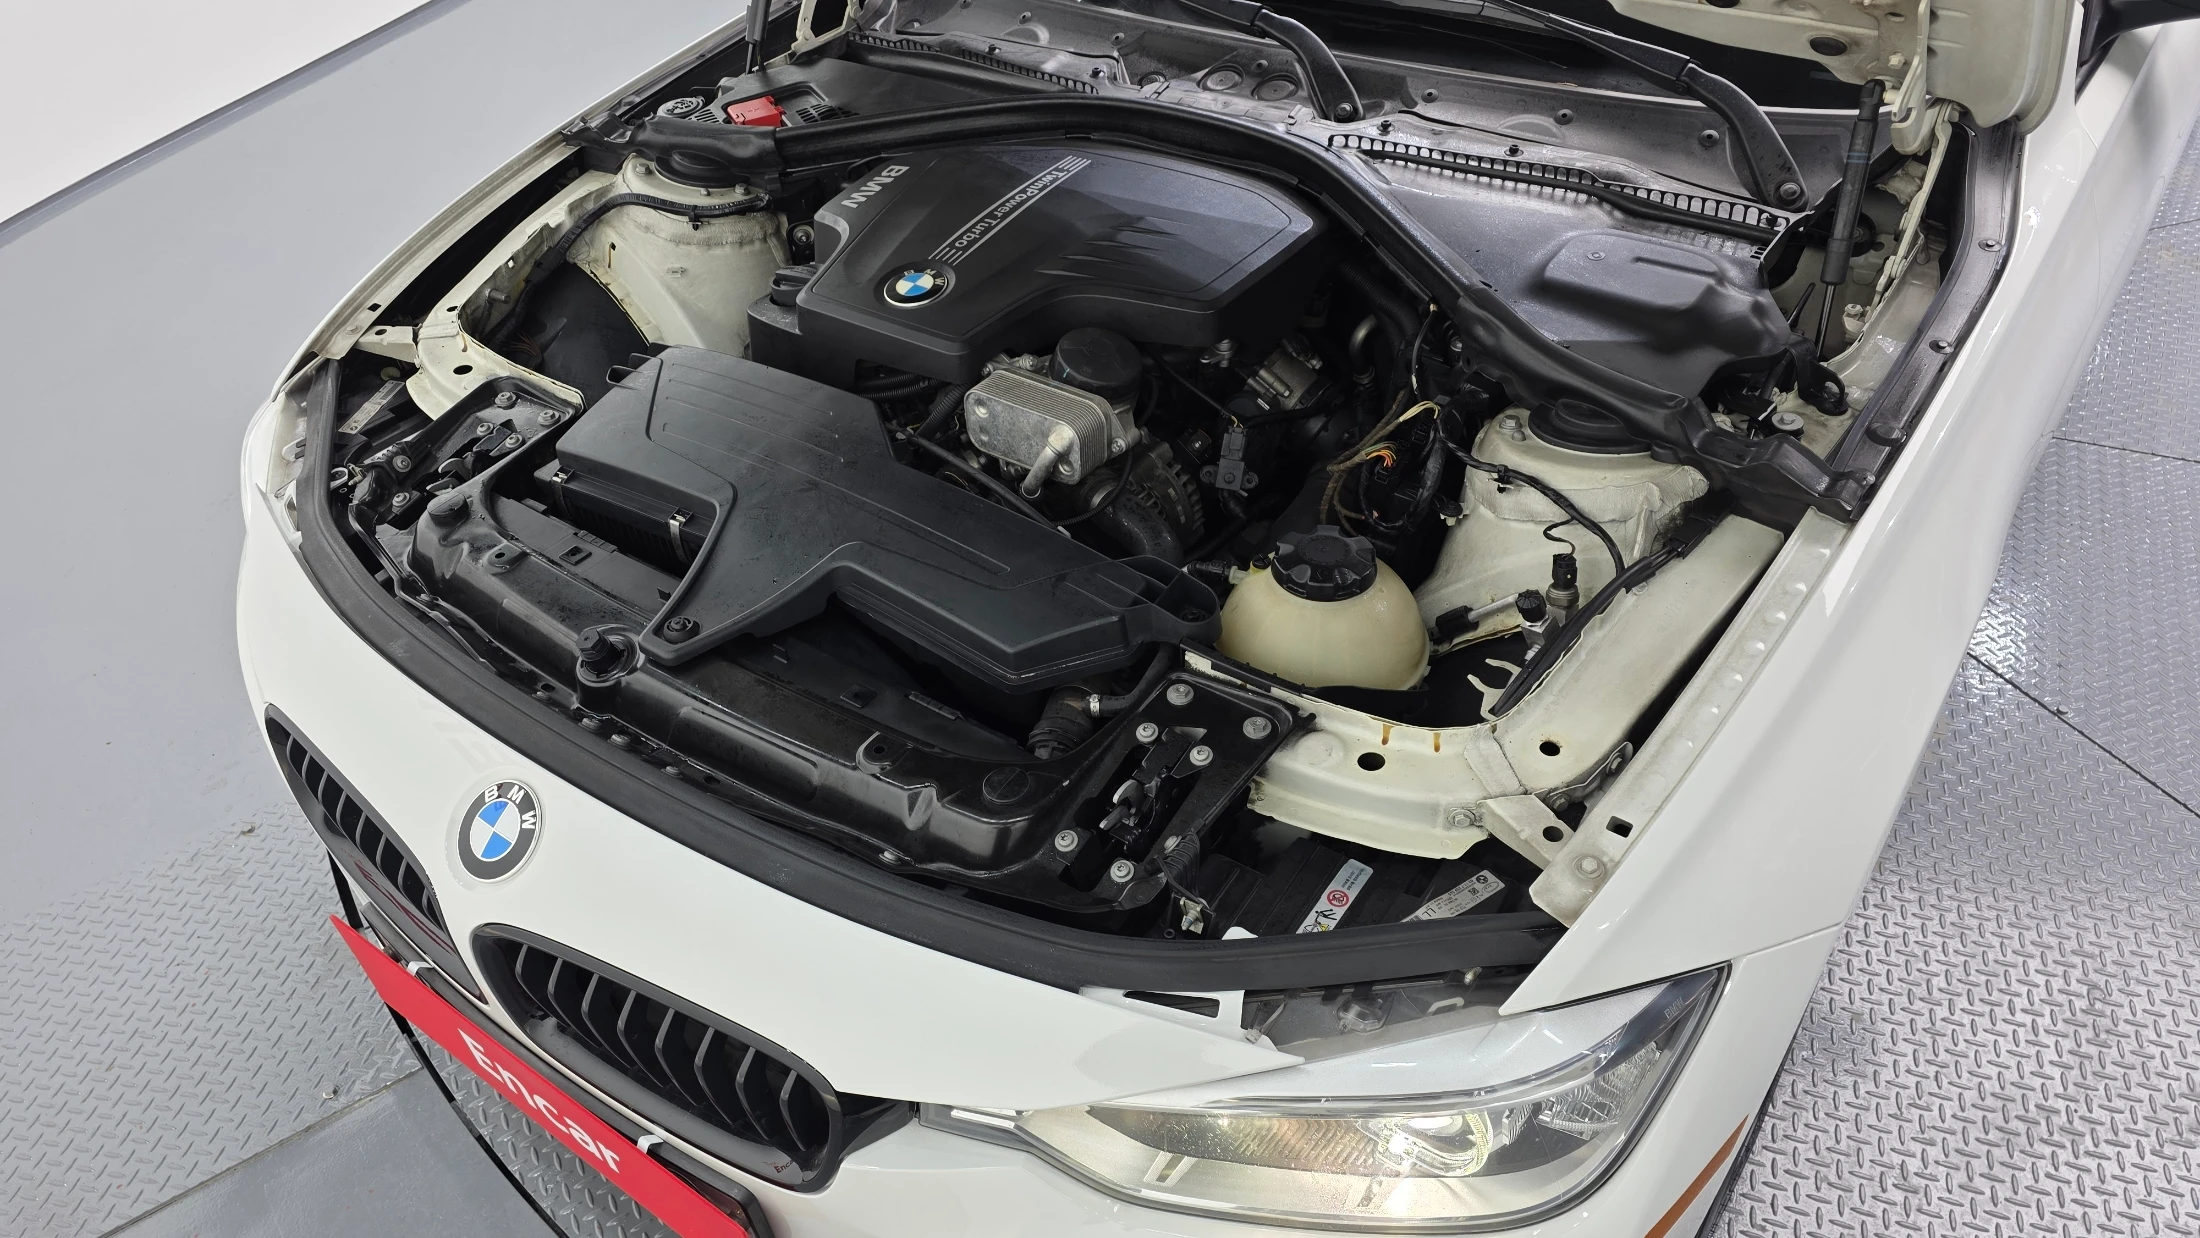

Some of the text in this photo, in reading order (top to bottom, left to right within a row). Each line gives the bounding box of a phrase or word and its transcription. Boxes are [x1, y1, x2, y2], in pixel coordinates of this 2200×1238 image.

[841, 165, 910, 209] BMW
[955, 218, 1001, 248] Turbo
[903, 268, 945, 286] BMW
[484, 784, 538, 830] BMW
[457, 1027, 620, 1174] Encar
